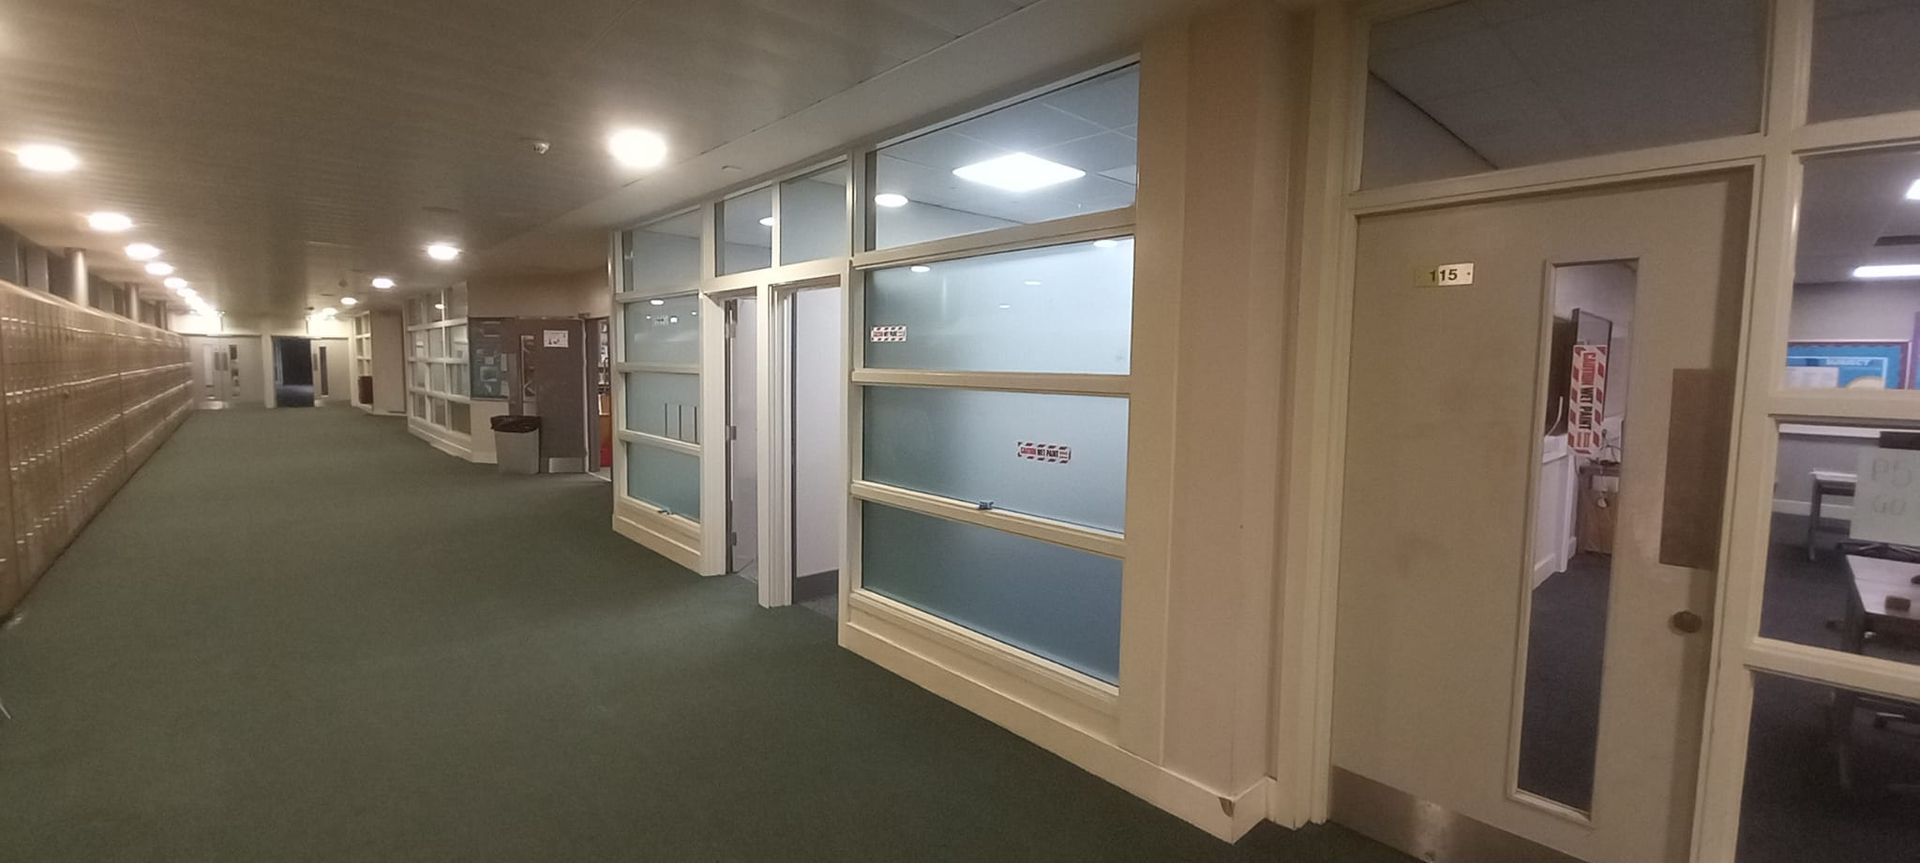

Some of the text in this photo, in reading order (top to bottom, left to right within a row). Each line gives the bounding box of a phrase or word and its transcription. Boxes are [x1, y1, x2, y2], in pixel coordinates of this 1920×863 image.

[1430, 268, 1458, 282] 115
[1581, 352, 1596, 386] CAUTION
[1580, 387, 1594, 404] WET
[1579, 406, 1593, 430] PAINT
[1046, 449, 1059, 458] PAINT
